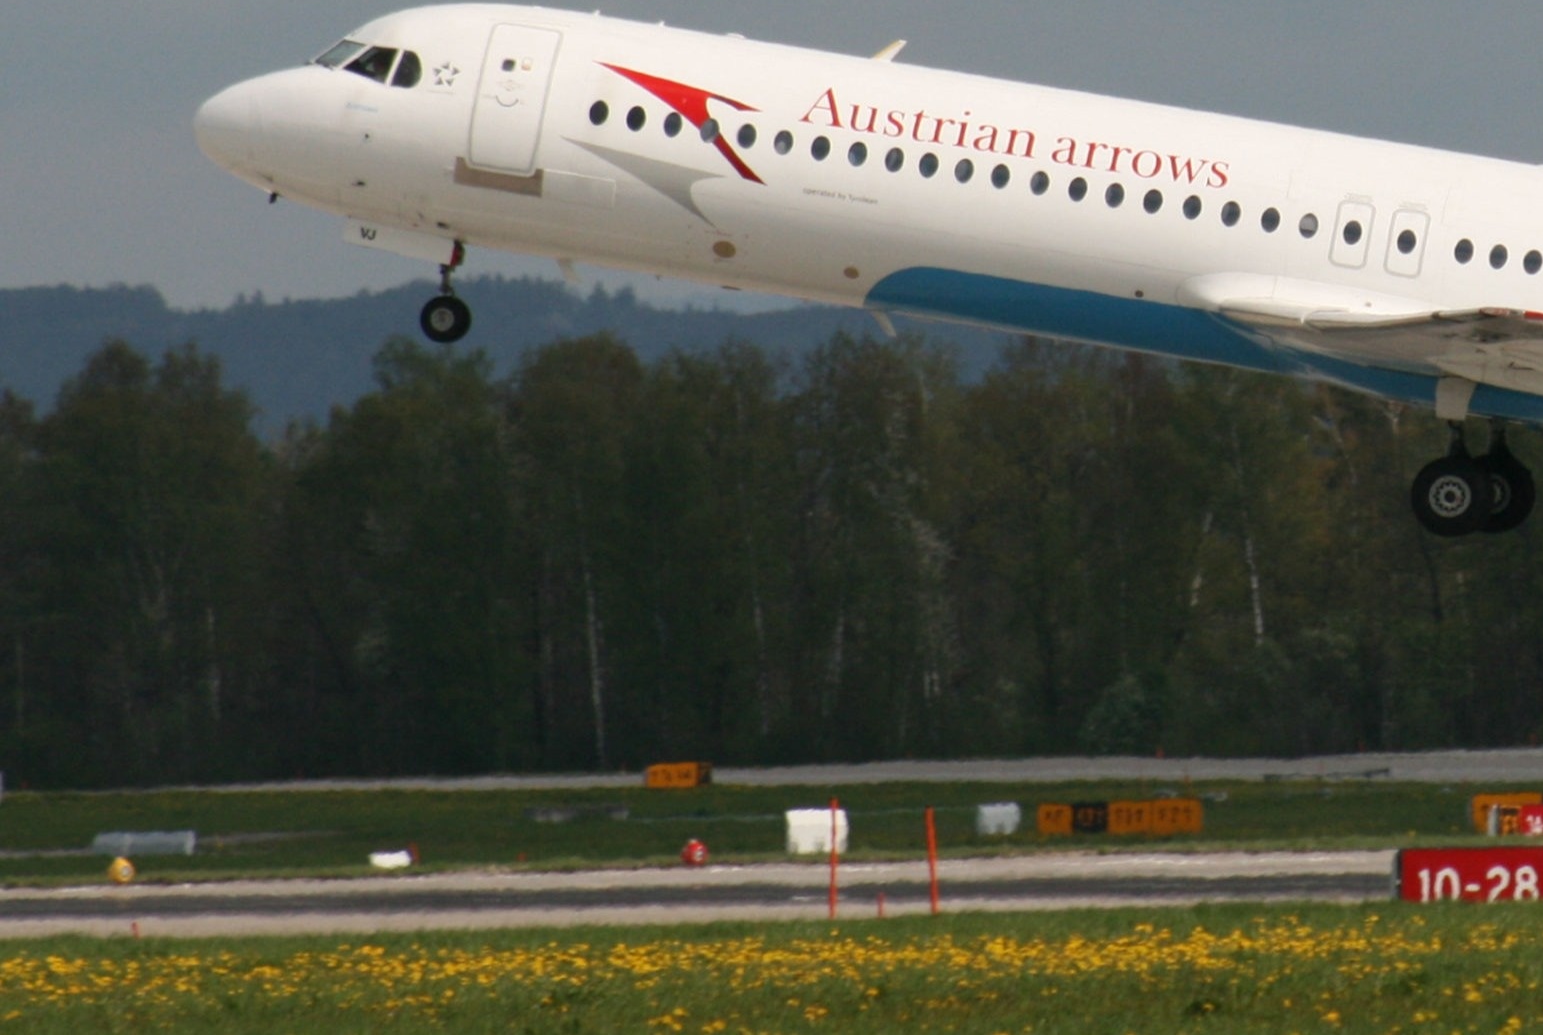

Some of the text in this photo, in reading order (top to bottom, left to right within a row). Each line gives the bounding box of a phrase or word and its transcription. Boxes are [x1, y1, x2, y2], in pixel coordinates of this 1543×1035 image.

[800, 87, 1229, 189] Austrian arrows
[360, 226, 377, 241] VJ
[1418, 865, 1540, 903] 10-28
